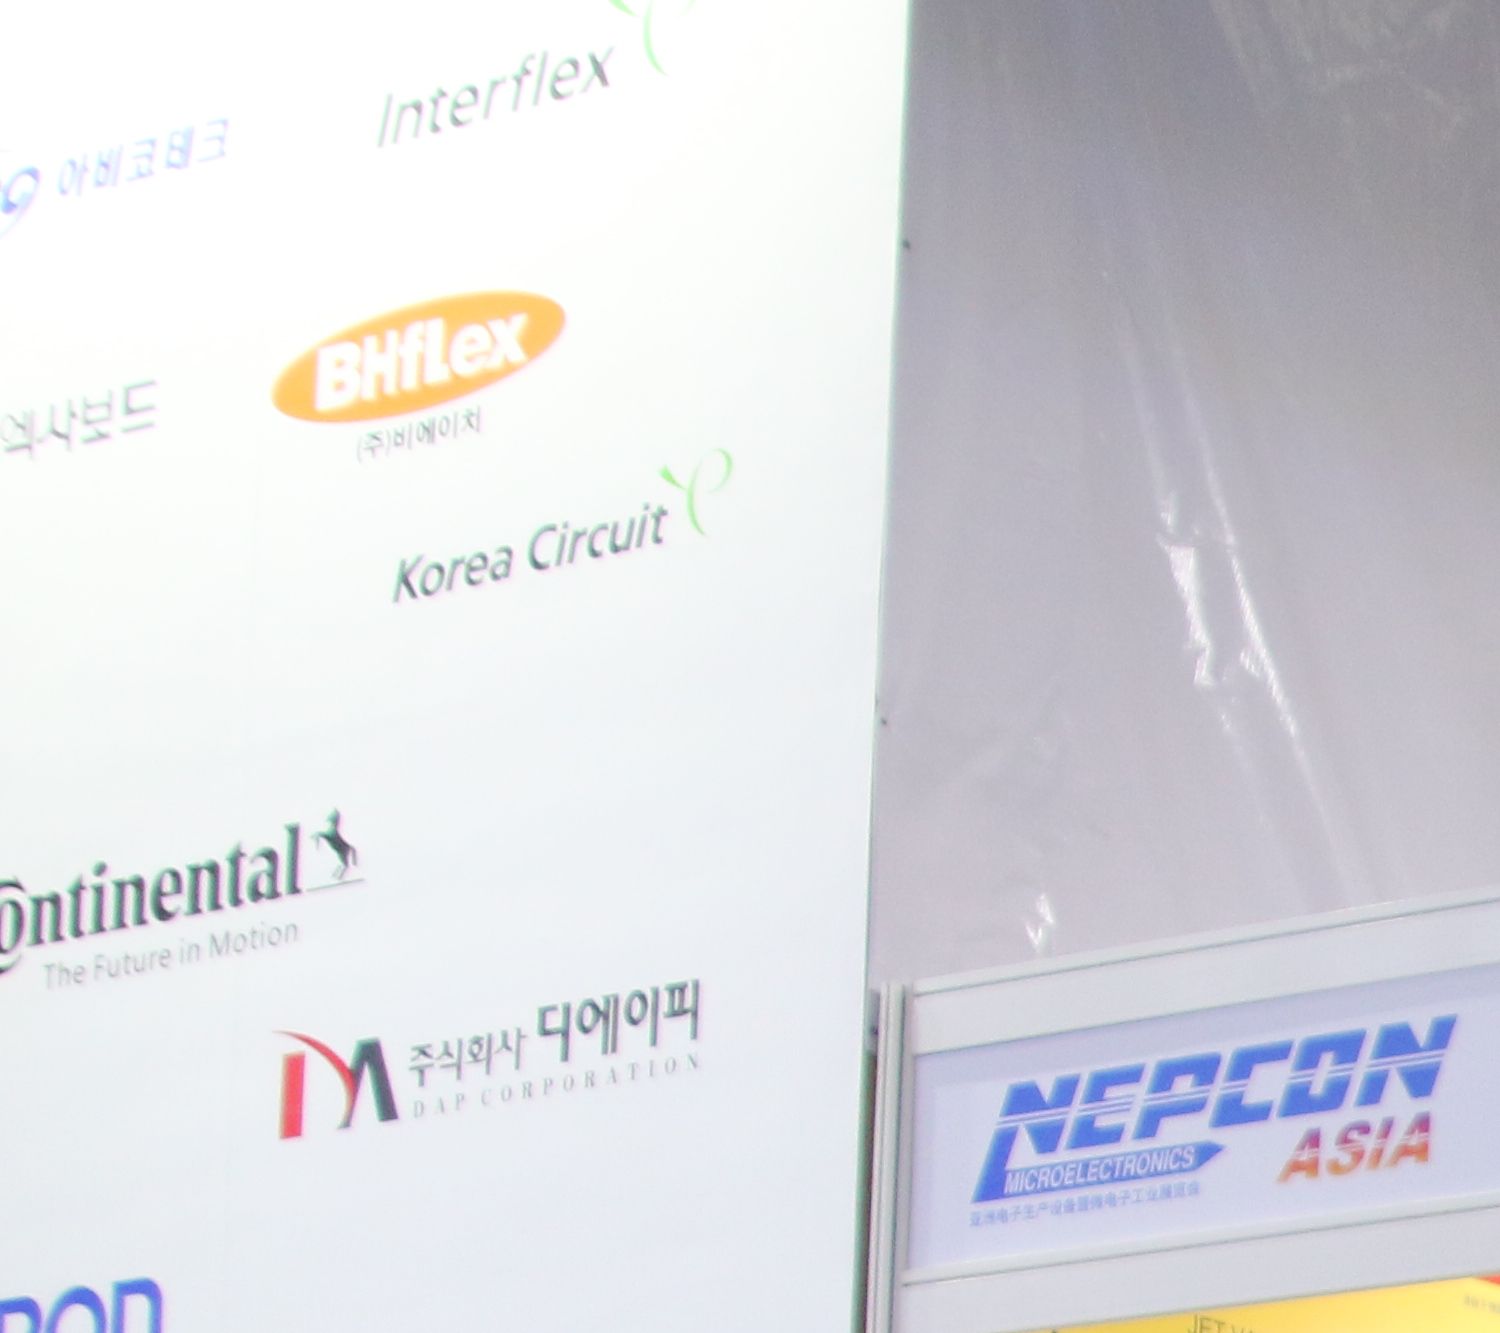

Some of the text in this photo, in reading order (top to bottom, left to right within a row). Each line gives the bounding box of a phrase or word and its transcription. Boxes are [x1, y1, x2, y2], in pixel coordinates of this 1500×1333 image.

[377, 45, 616, 149] Interflex
[391, 502, 667, 603] Korea Circuit
[44, 920, 299, 990] The Future in Motion
[408, 979, 700, 1088] 주식회사 디에이피
[480, 1052, 701, 1108] CORPORATION
[971, 1012, 1459, 1204] NEPCON
[1003, 1147, 1195, 1196] MICROELECTRONICS
[1275, 1109, 1433, 1185] ASIA
